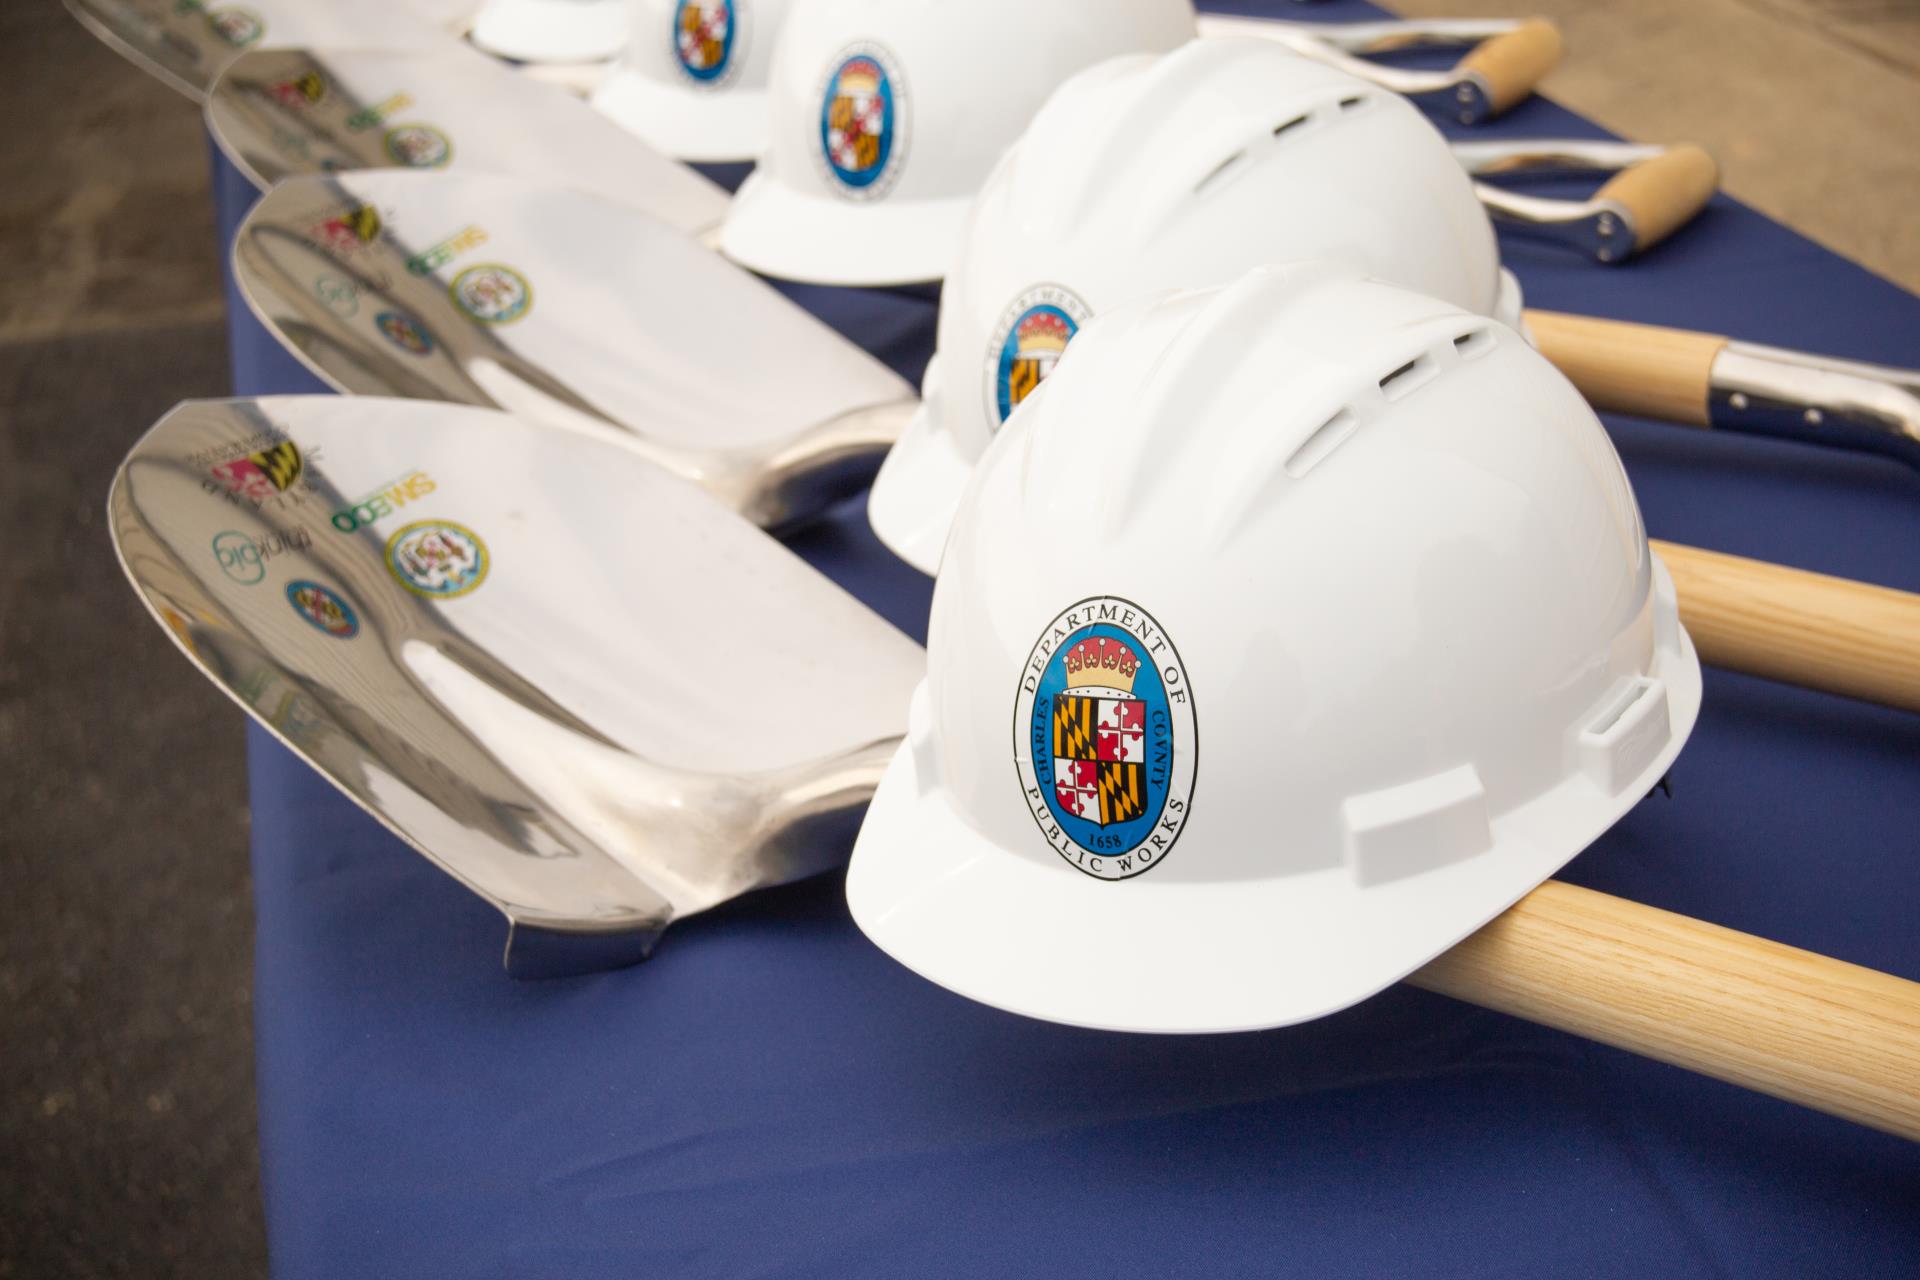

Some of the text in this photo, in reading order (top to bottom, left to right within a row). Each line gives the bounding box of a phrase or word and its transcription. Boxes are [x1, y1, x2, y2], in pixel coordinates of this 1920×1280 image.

[332, 472, 436, 533] SMECO
[1024, 604, 1185, 704] DEPARTMENT OF
[1036, 697, 1051, 785] CHARLES
[1027, 787, 1184, 872] PUBLIC WORKS
[1088, 833, 1122, 849] 1658
